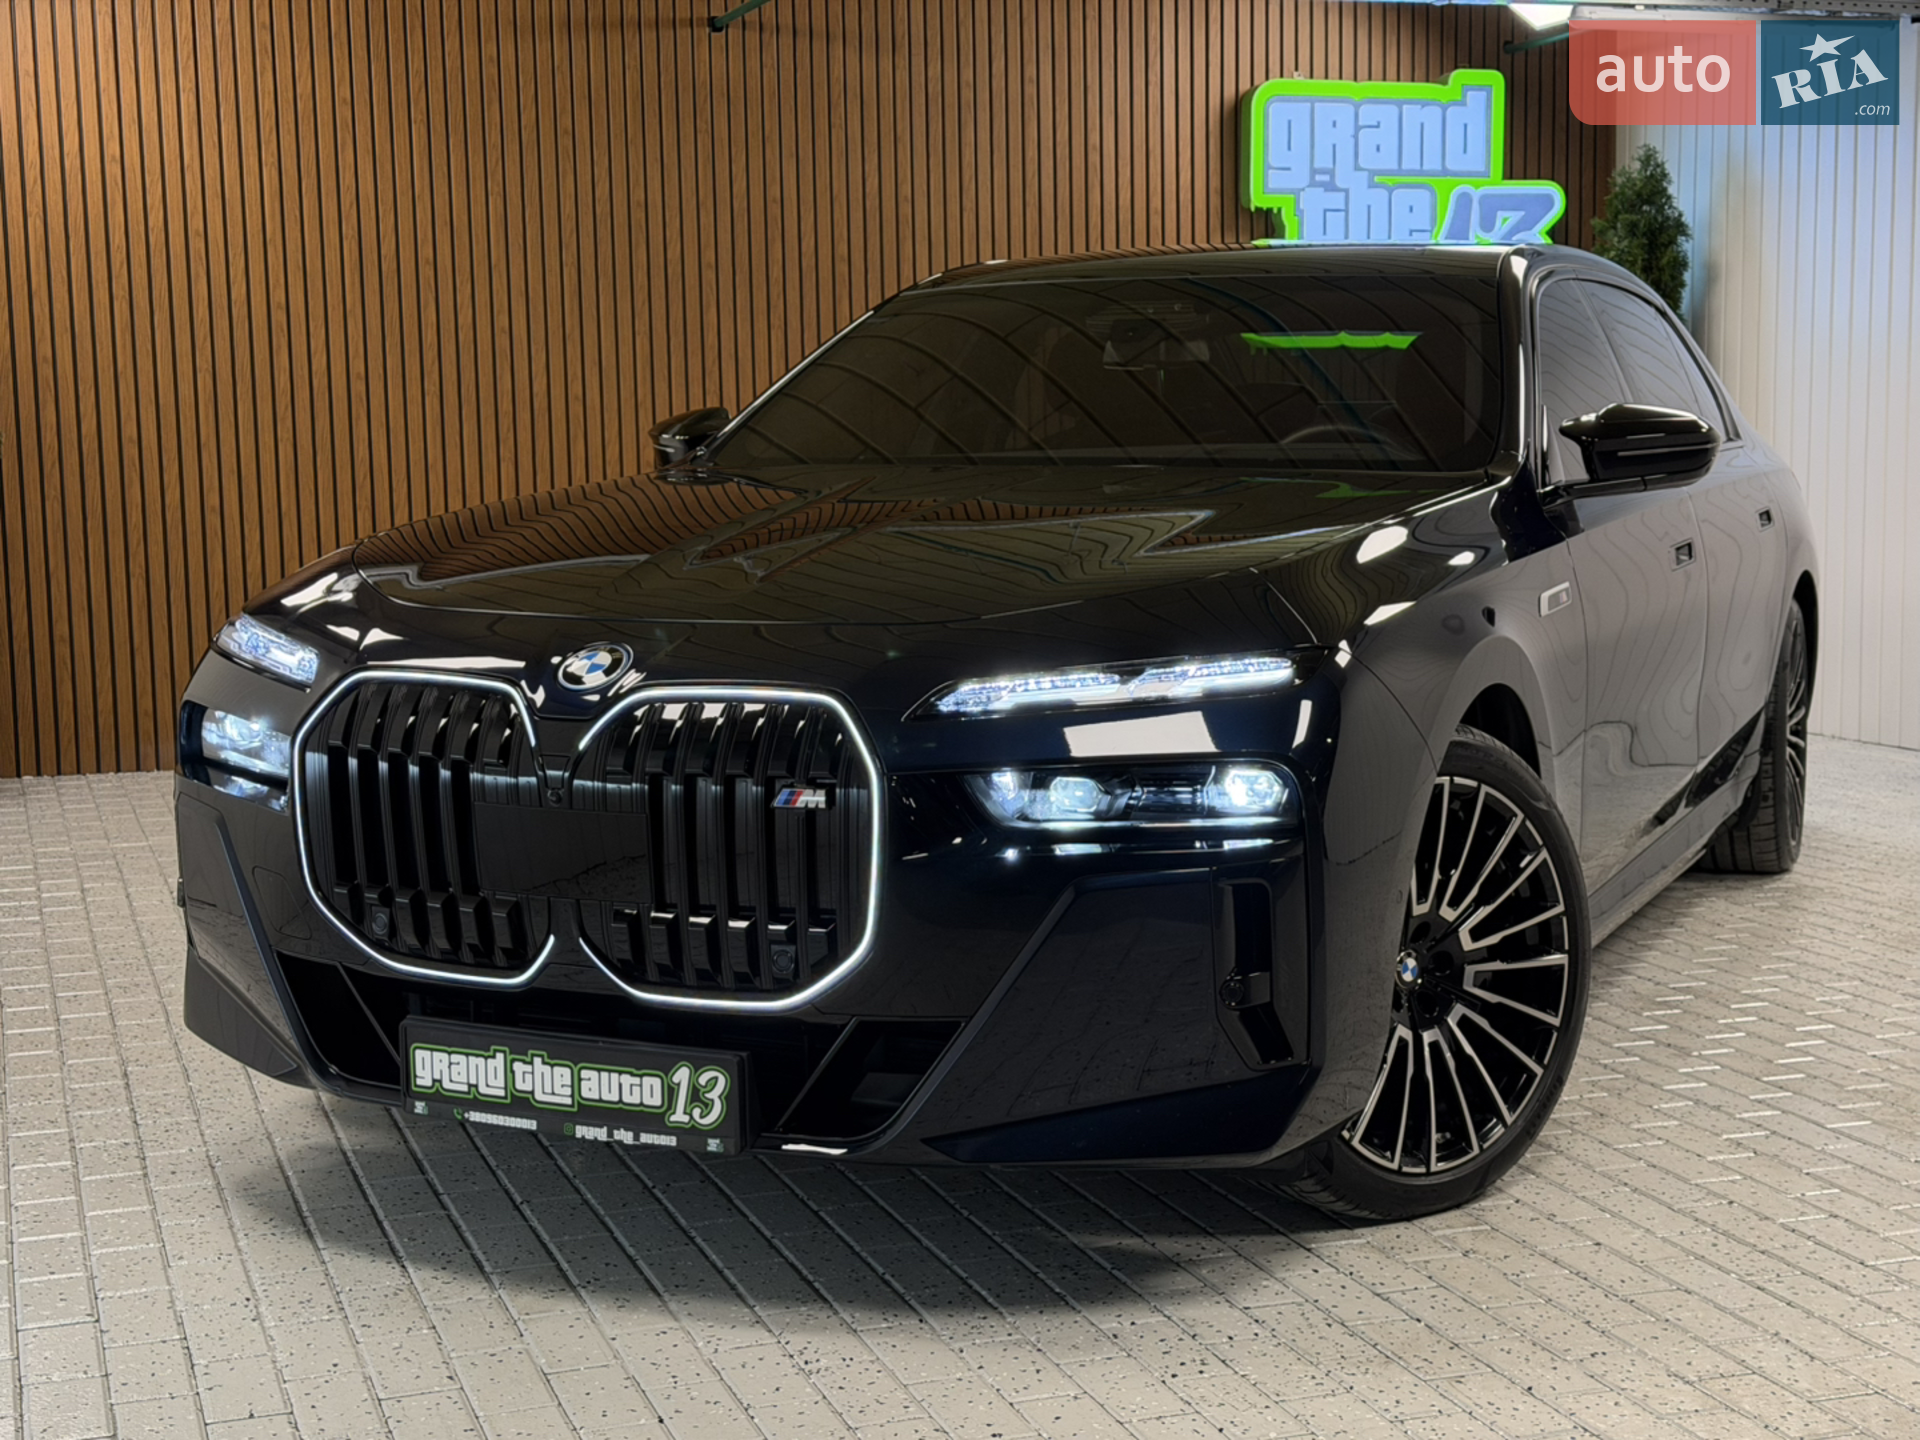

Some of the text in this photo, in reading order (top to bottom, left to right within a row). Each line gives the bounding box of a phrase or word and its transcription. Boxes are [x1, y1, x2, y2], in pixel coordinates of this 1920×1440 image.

[1268, 90, 1488, 189] grand
[1300, 171, 1432, 243] the
[414, 1047, 728, 1126] grand the auto 13
